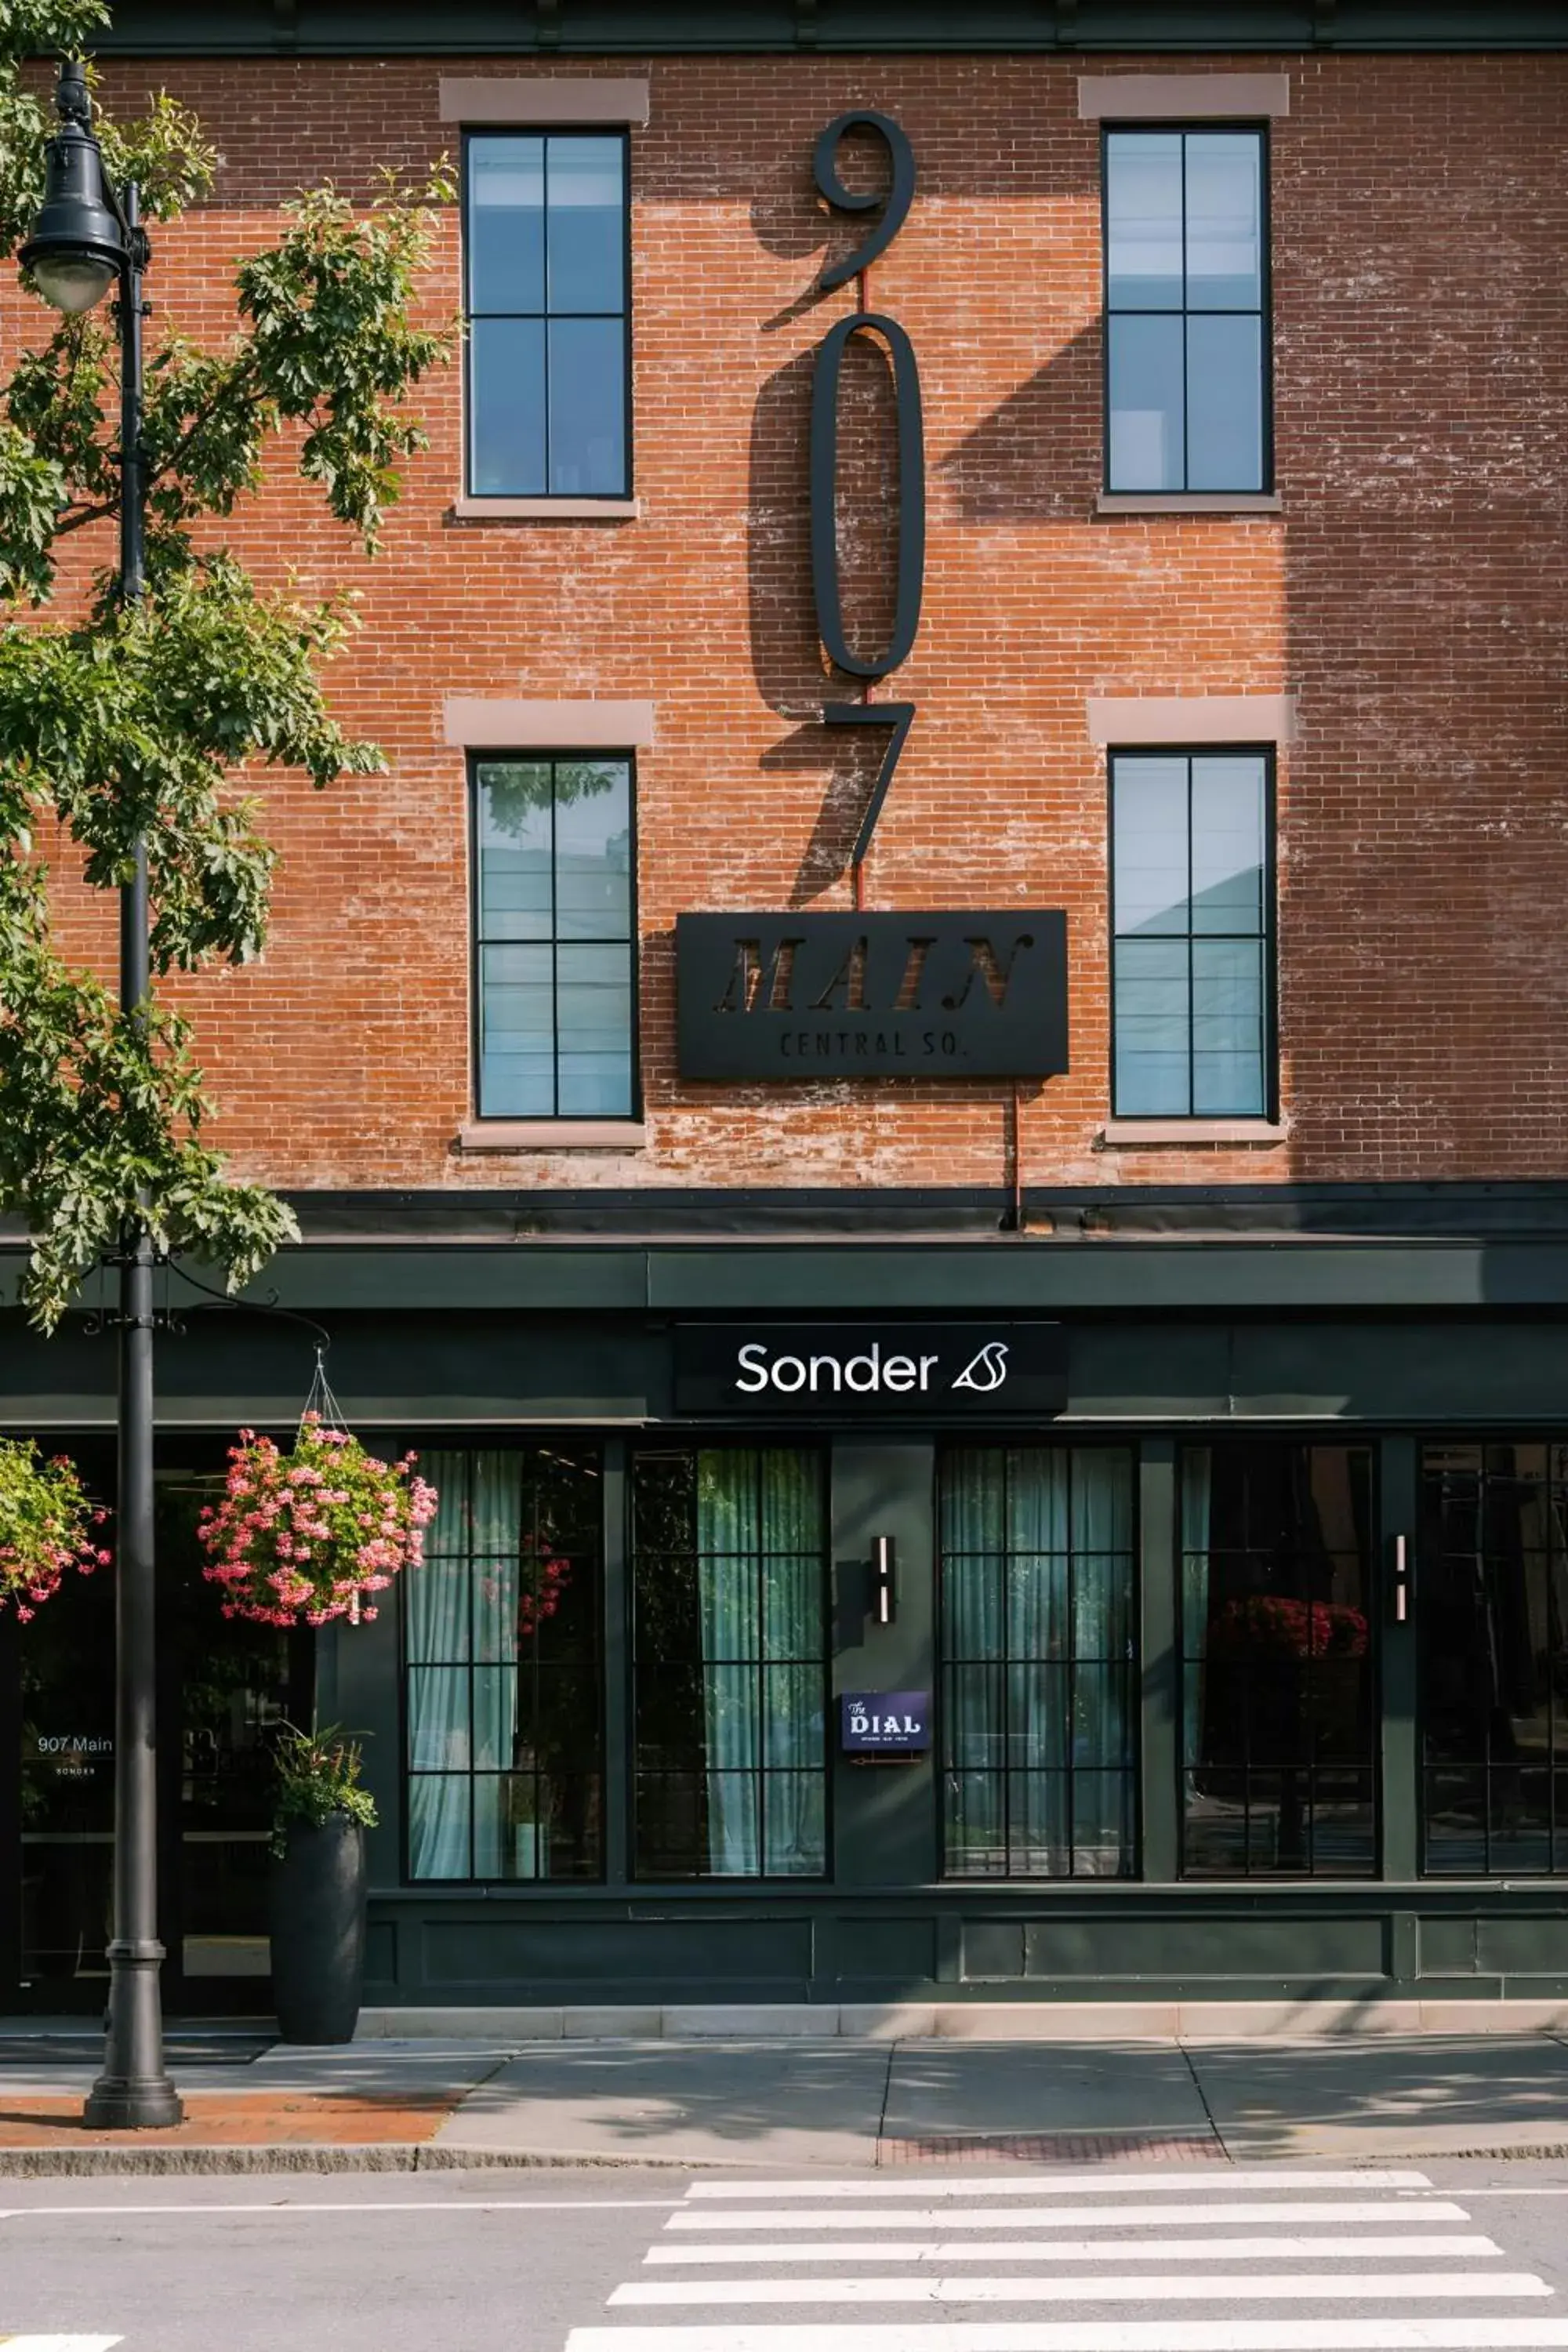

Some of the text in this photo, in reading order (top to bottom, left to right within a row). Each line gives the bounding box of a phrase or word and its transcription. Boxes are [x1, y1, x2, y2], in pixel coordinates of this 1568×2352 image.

[811, 109, 925, 864] 907
[712, 934, 1035, 1012] MAIN
[780, 1031, 906, 1057] CENTRAL
[735, 1342, 938, 1392] Sonder
[848, 1700, 866, 1715] The
[851, 1715, 921, 1733] DIAL
[38, 1737, 113, 1752] 907 Main
